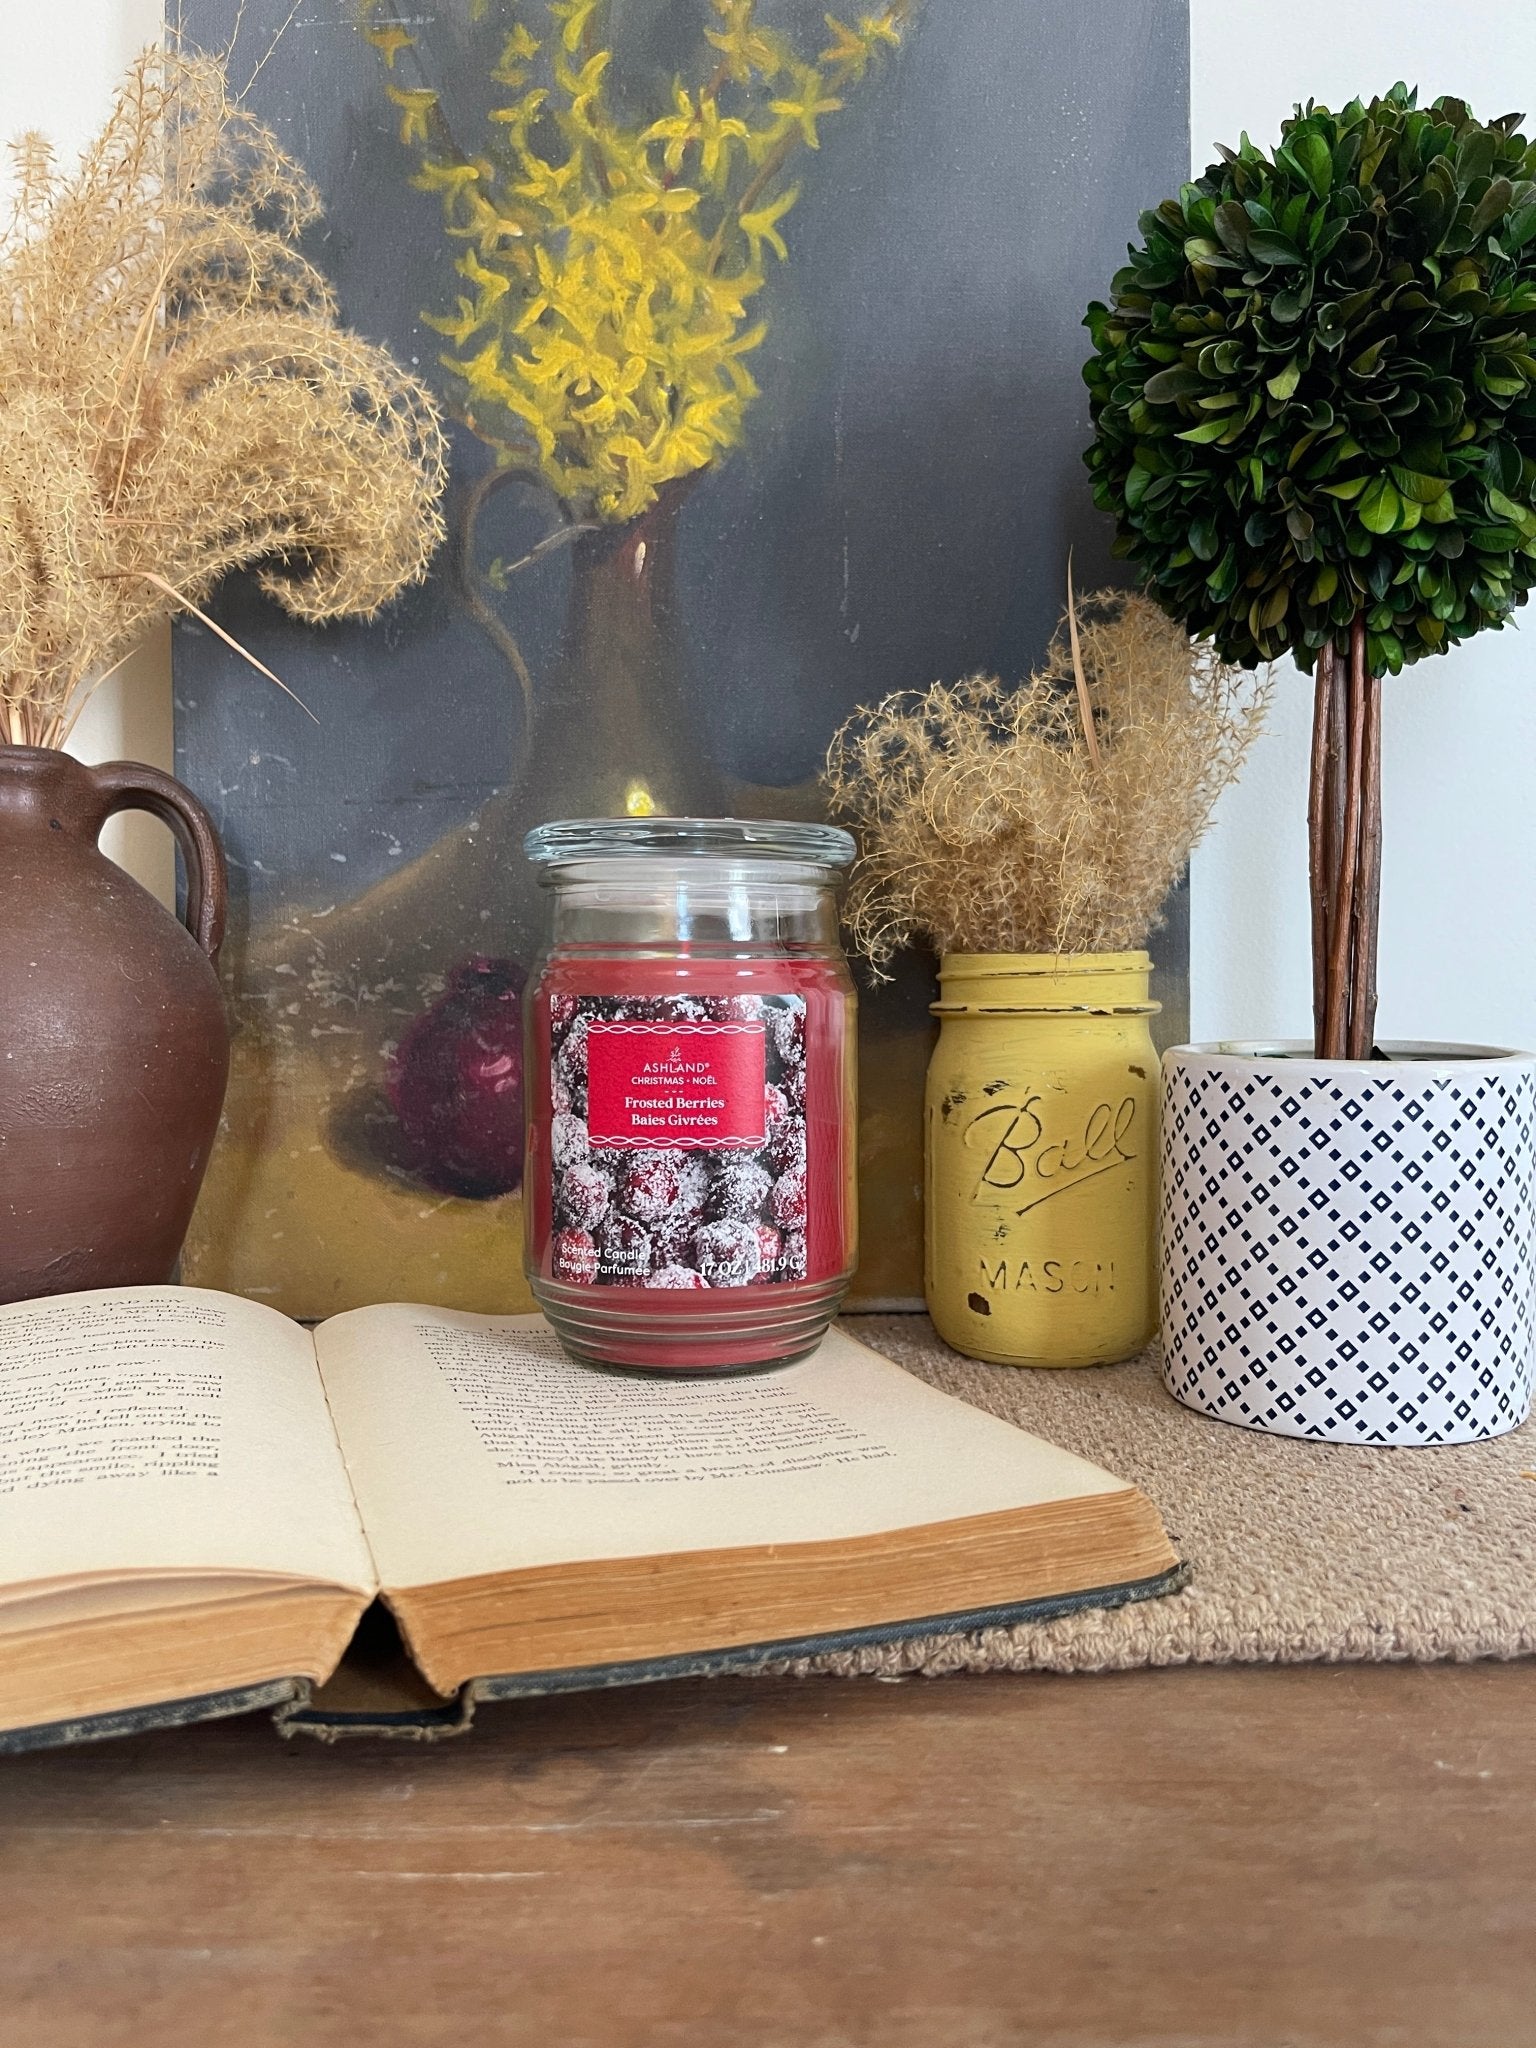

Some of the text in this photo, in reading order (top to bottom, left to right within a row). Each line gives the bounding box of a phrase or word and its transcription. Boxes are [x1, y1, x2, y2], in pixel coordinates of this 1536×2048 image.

[631, 1075, 718, 1085] CHRISTMAS NOËL
[624, 1096, 725, 1109] Frosted Berries
[631, 1113, 718, 1126] Baies Givrées
[963, 1096, 1137, 1200] Ball
[561, 1243, 646, 1262] Scented Candle
[559, 1257, 650, 1276] Bougie Parfumée
[700, 1262, 714, 1276] 17
